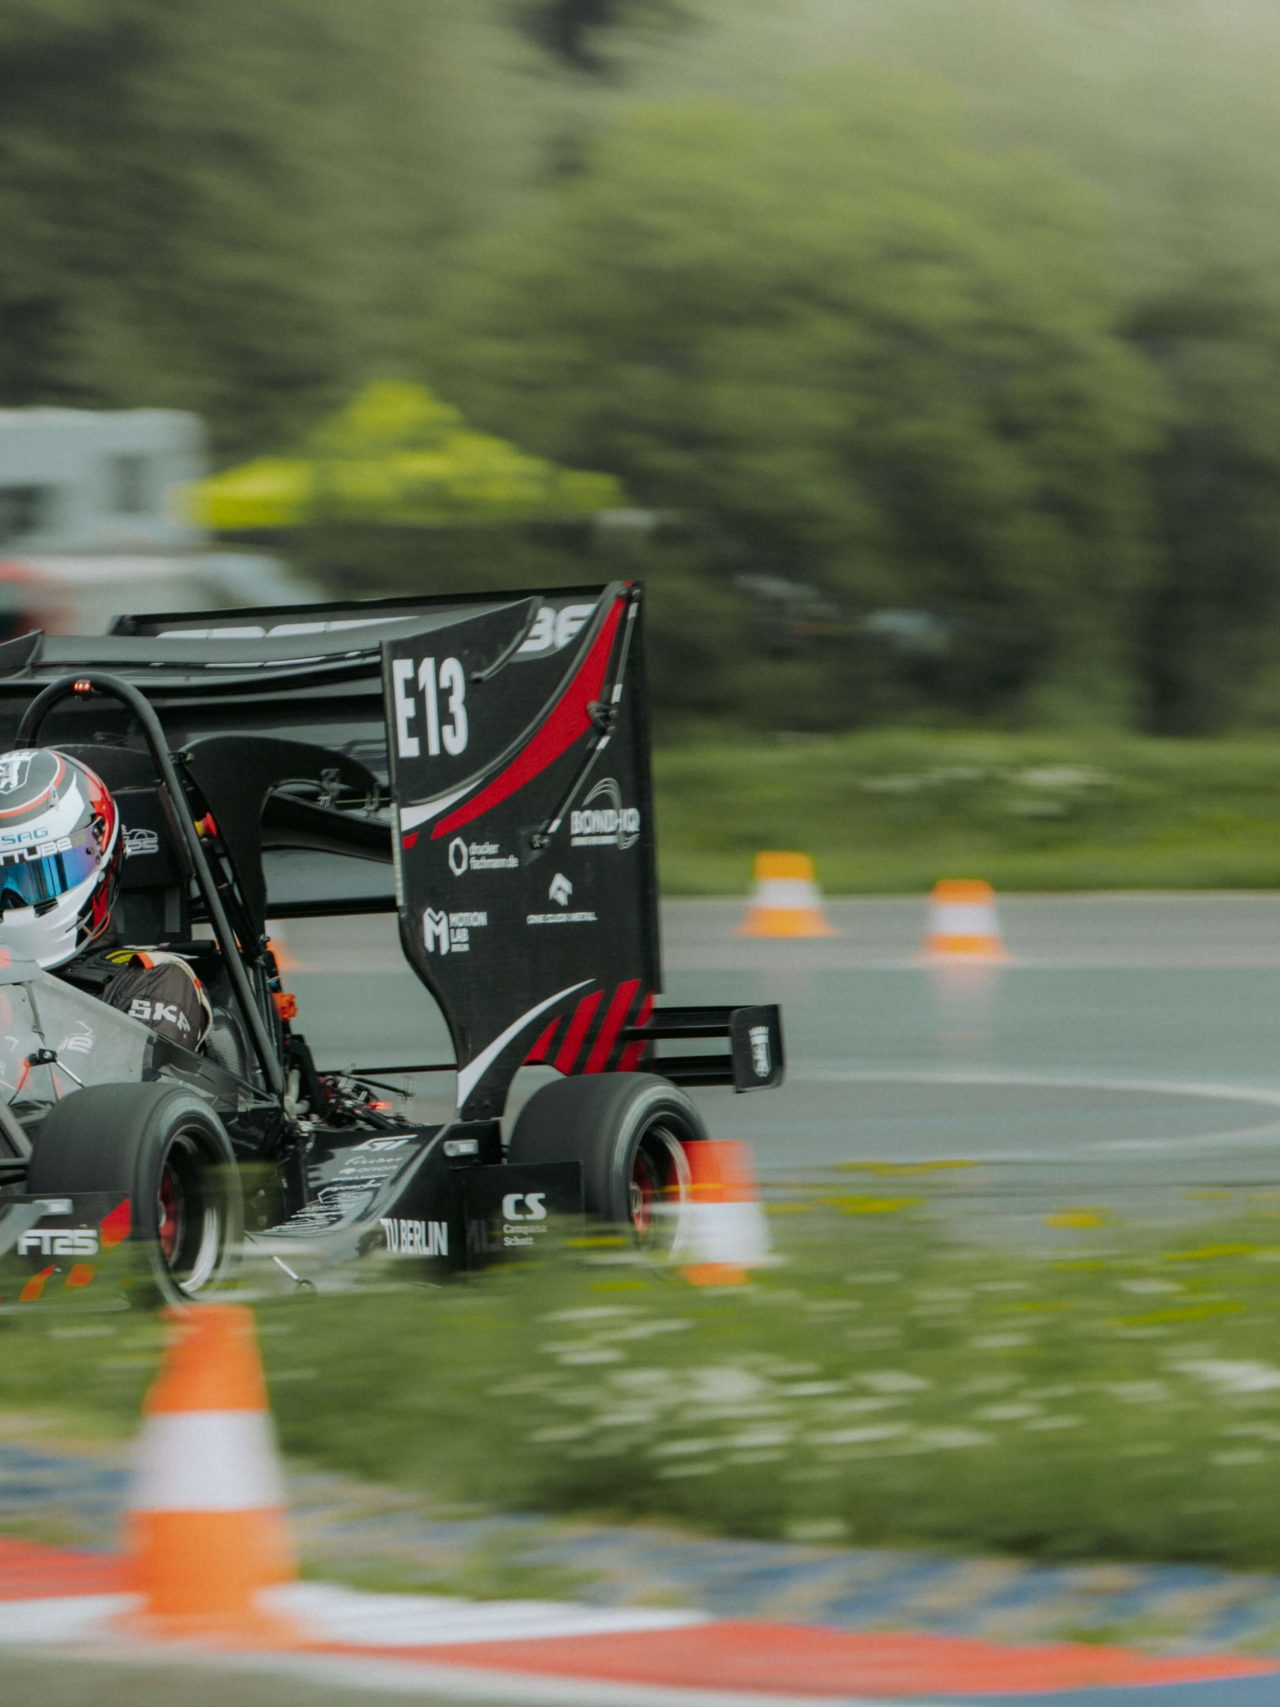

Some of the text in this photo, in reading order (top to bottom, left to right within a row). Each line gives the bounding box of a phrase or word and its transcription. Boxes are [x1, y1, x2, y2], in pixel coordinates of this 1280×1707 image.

[392, 657, 469, 759] E13
[502, 1192, 547, 1221] CS
[17, 1228, 100, 1256] FT25
[400, 1218, 449, 1256] BERLIN
